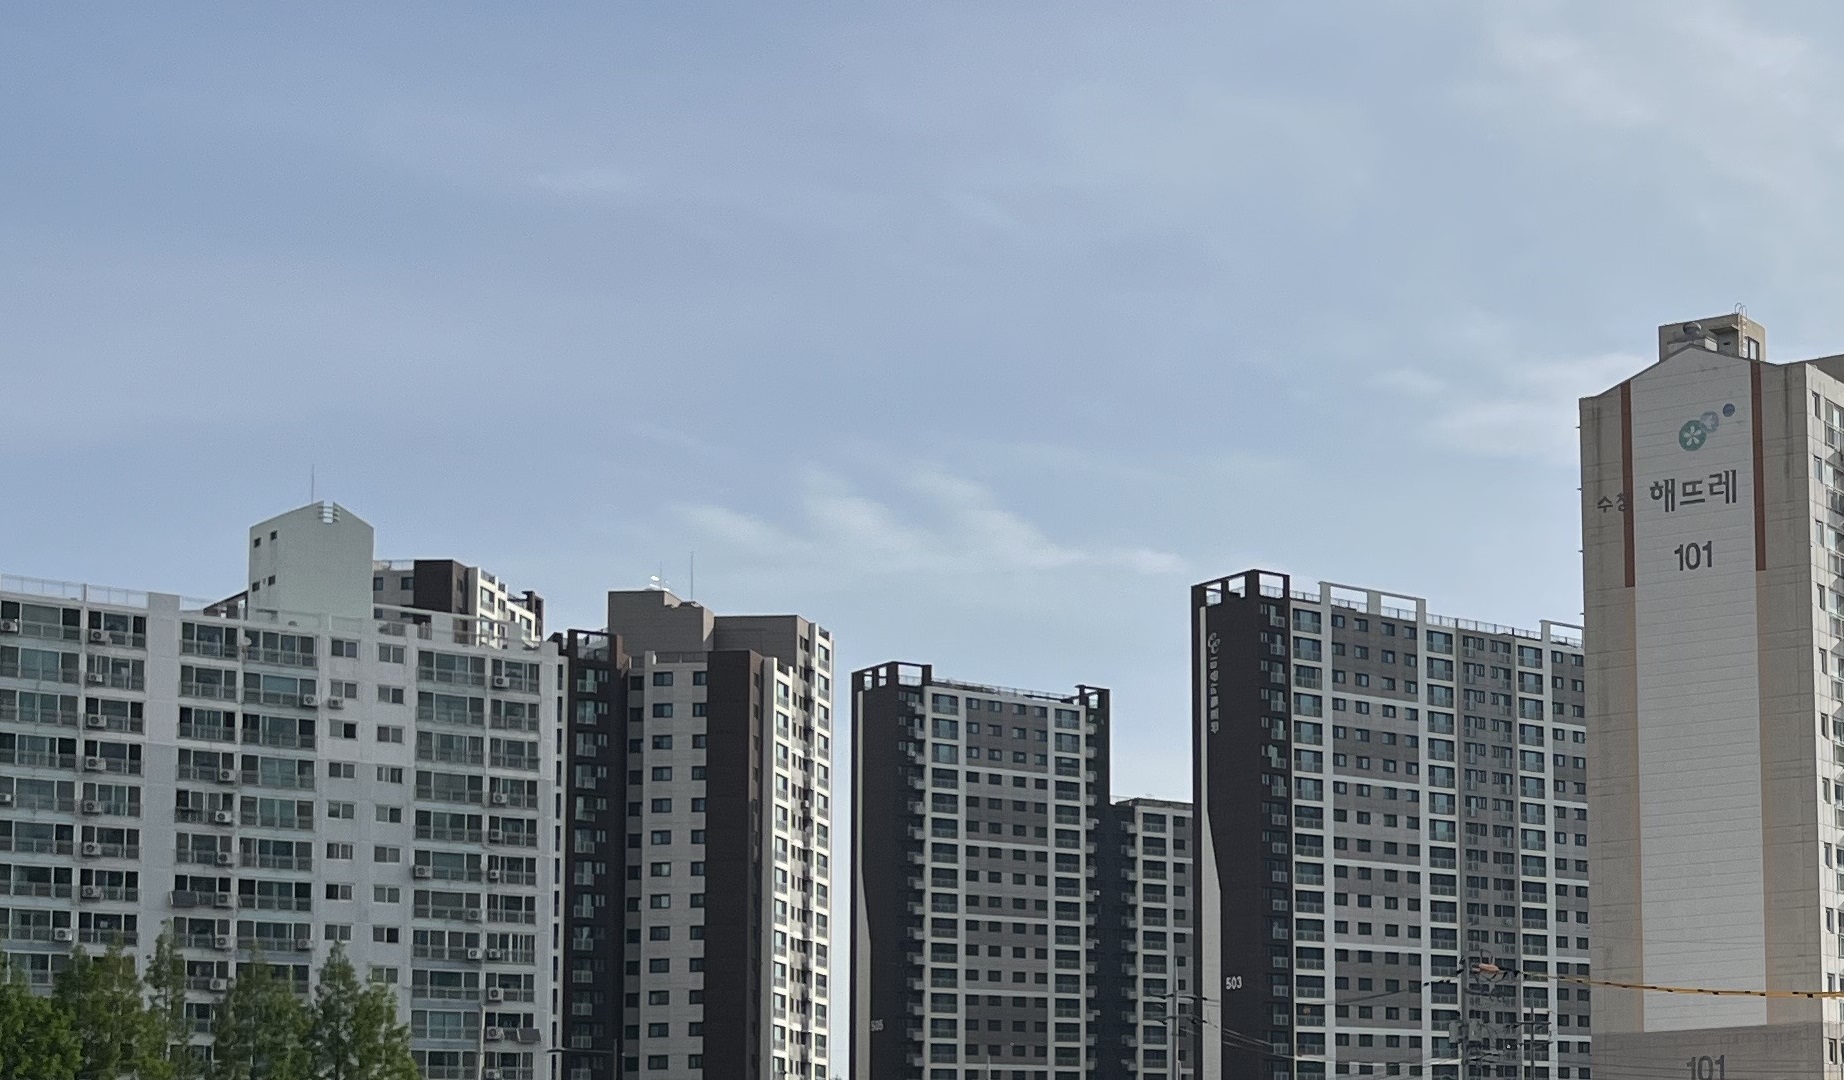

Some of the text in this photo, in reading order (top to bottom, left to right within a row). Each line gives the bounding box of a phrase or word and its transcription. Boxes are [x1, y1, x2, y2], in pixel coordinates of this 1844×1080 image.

[1650, 469, 1737, 513] 해뜨레
[1674, 541, 1712, 571] 101
[1226, 976, 1242, 990] 503
